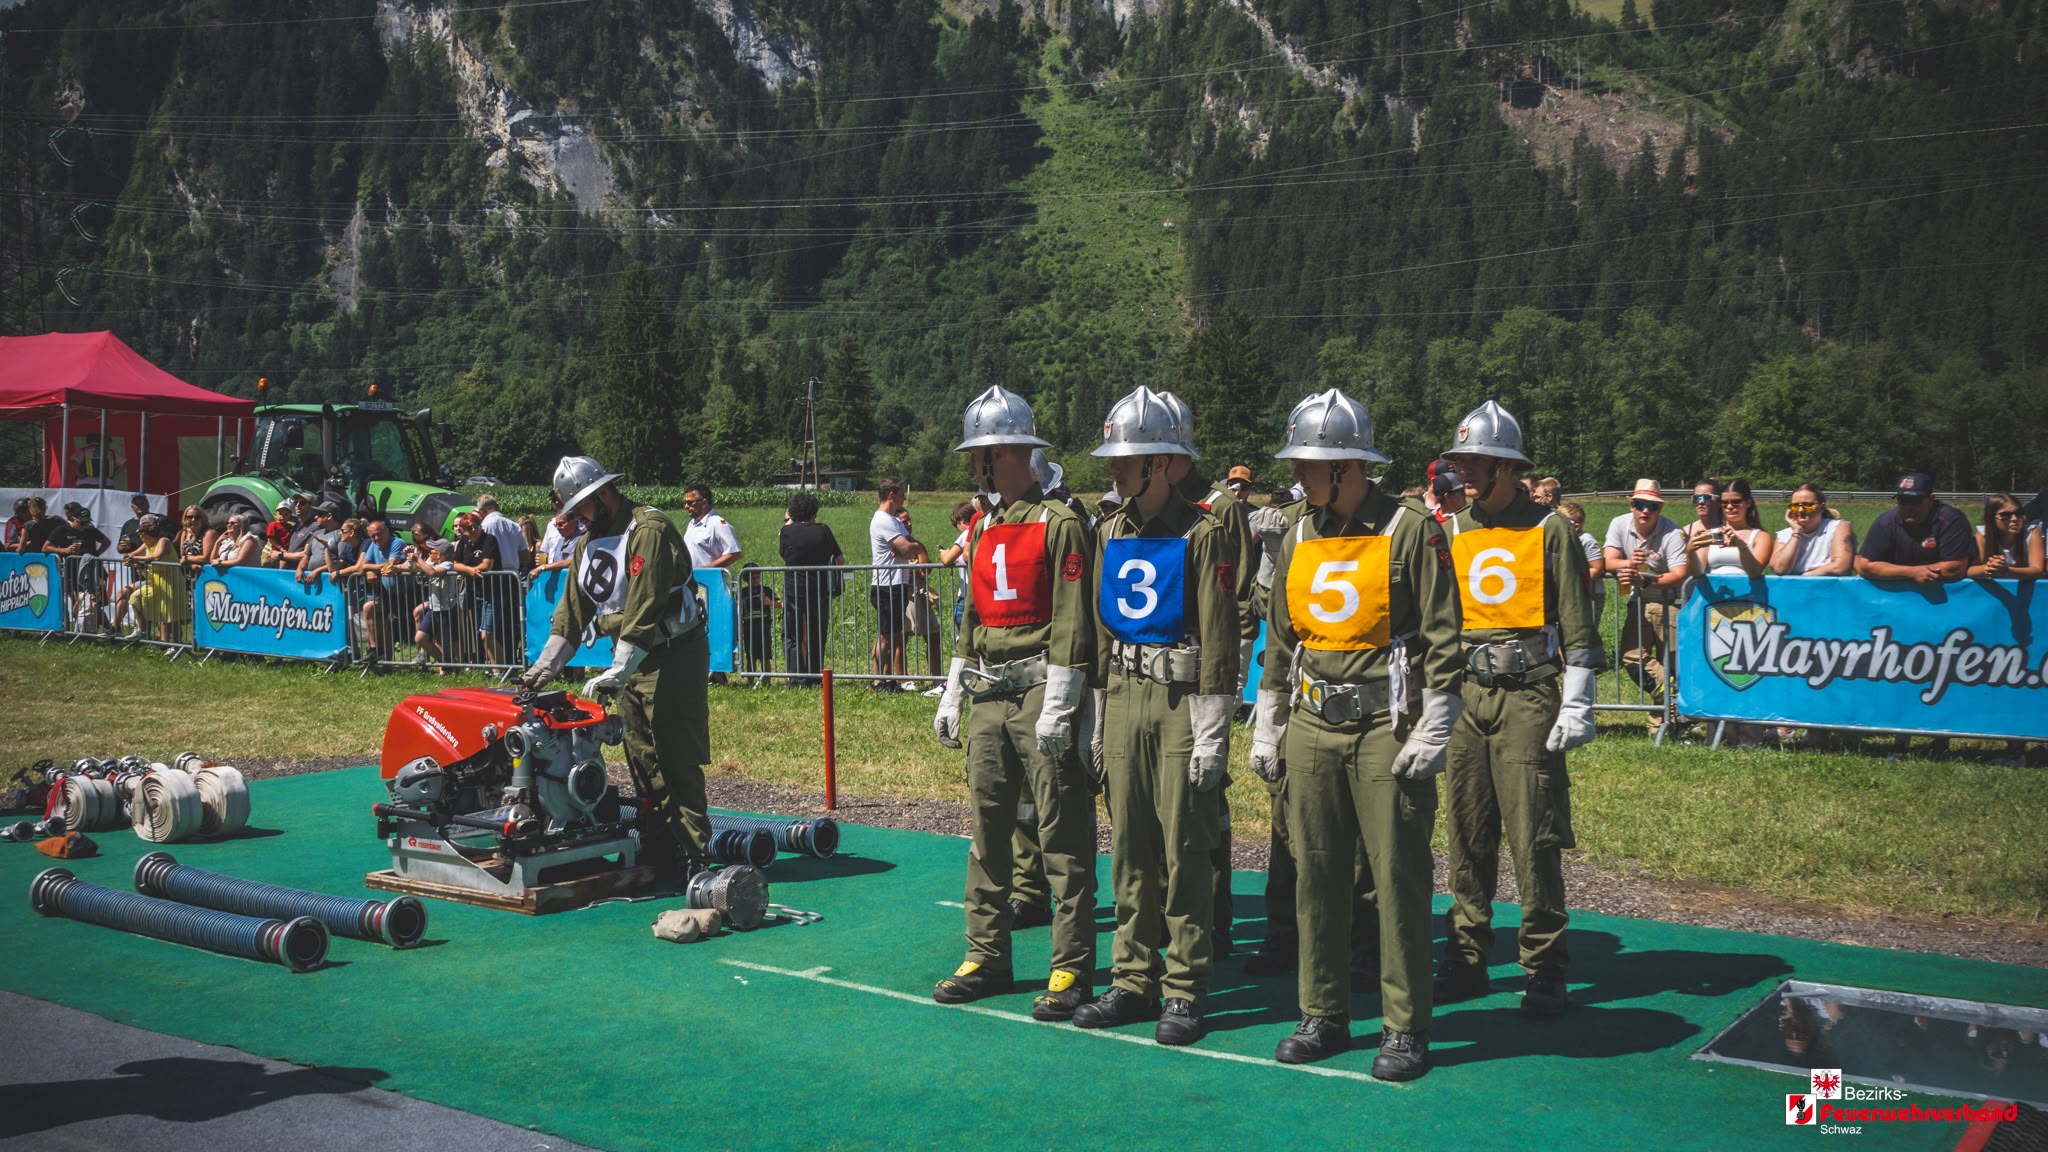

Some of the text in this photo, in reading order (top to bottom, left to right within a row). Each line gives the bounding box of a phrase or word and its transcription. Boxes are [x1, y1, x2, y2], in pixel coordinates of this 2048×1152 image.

[0, 570, 29, 598] ofen
[991, 543, 1018, 601] 1
[1117, 558, 1158, 620] 3
[1308, 560, 1360, 623] 5
[1468, 547, 1517, 605] 6
[211, 592, 333, 639] Mayrhofen.at
[1723, 620, 2048, 703] Mayrhofen.
[416, 706, 424, 715] FF
